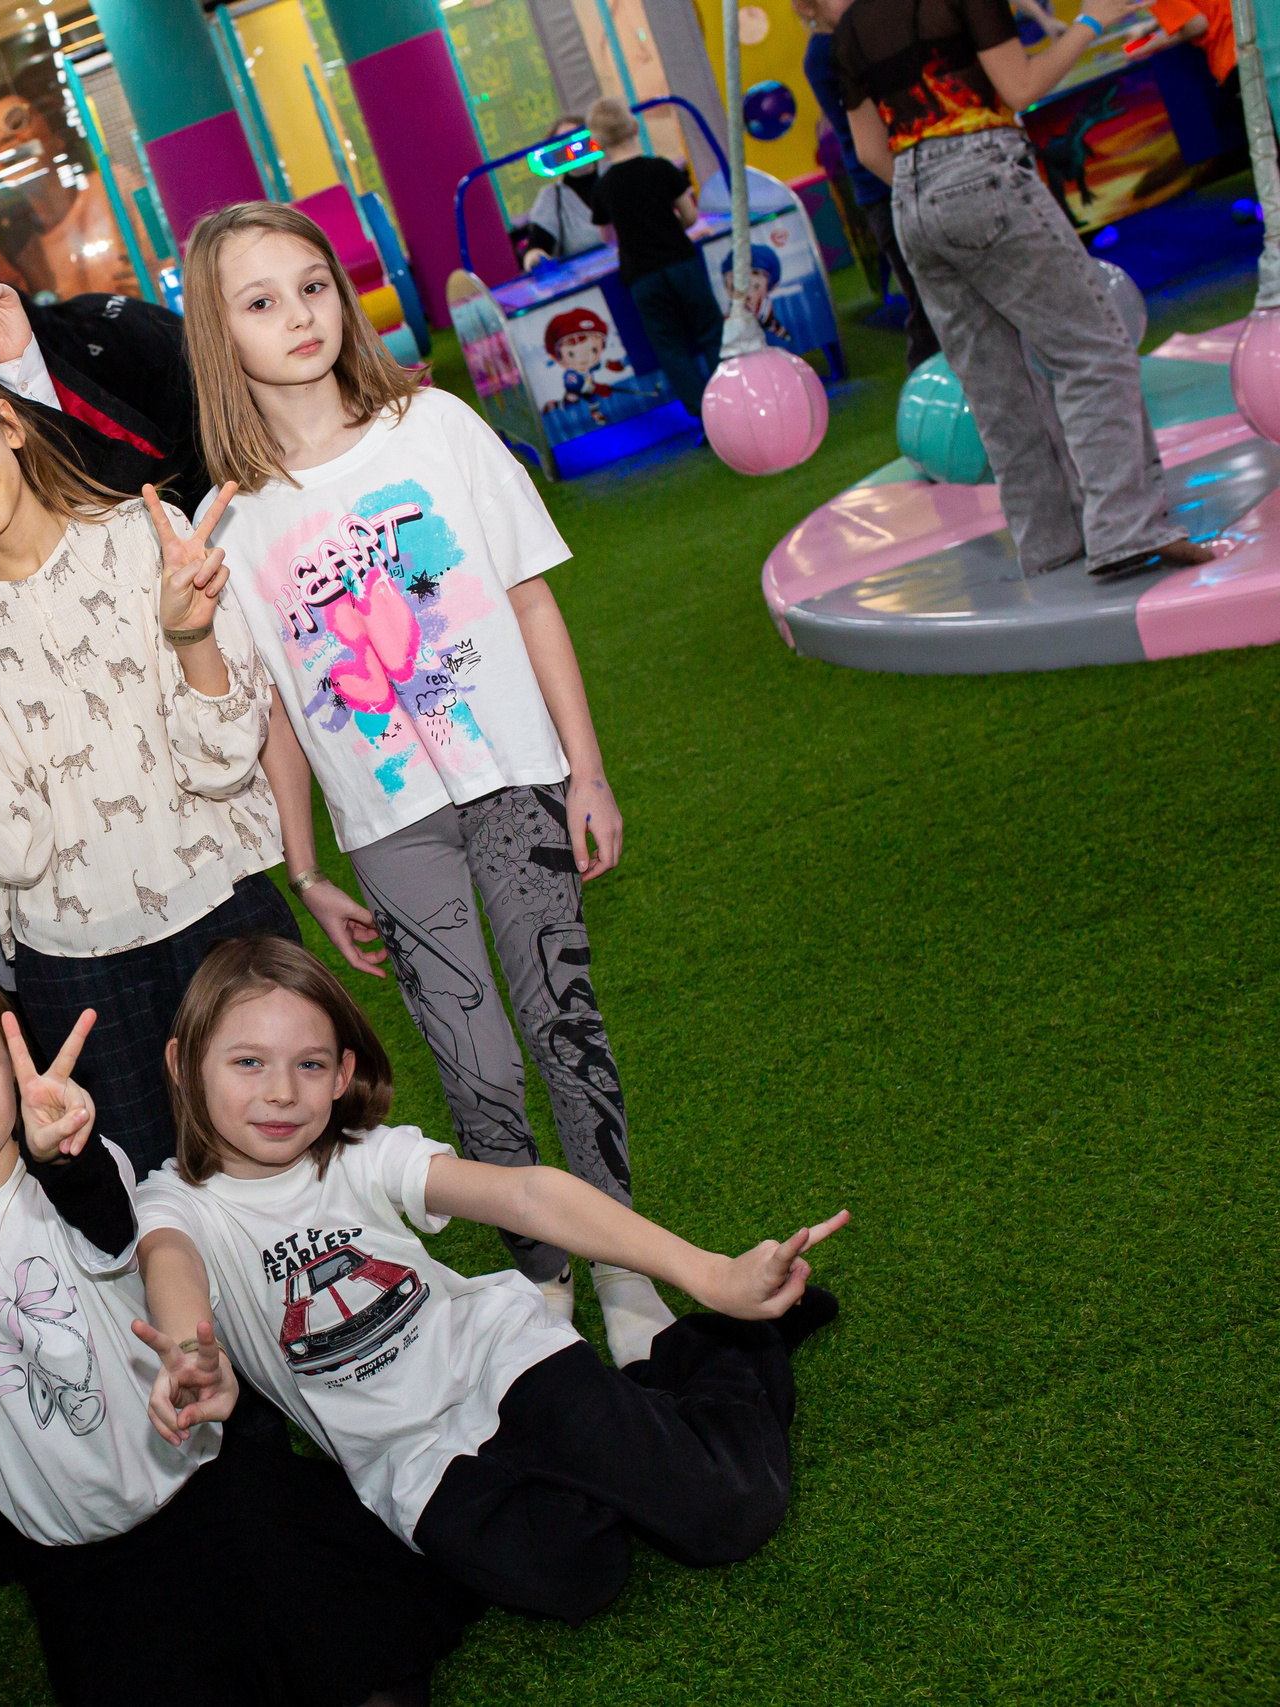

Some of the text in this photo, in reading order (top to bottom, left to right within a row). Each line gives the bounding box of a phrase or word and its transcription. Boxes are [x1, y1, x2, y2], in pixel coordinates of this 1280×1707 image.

[274, 502, 423, 640] HEART
[262, 1232, 299, 1268] AST
[355, 1360, 377, 1377] ENJOY
[386, 1348, 396, 1358] ON
[359, 1371, 373, 1381] THE
[338, 1374, 353, 1383] TAKE
